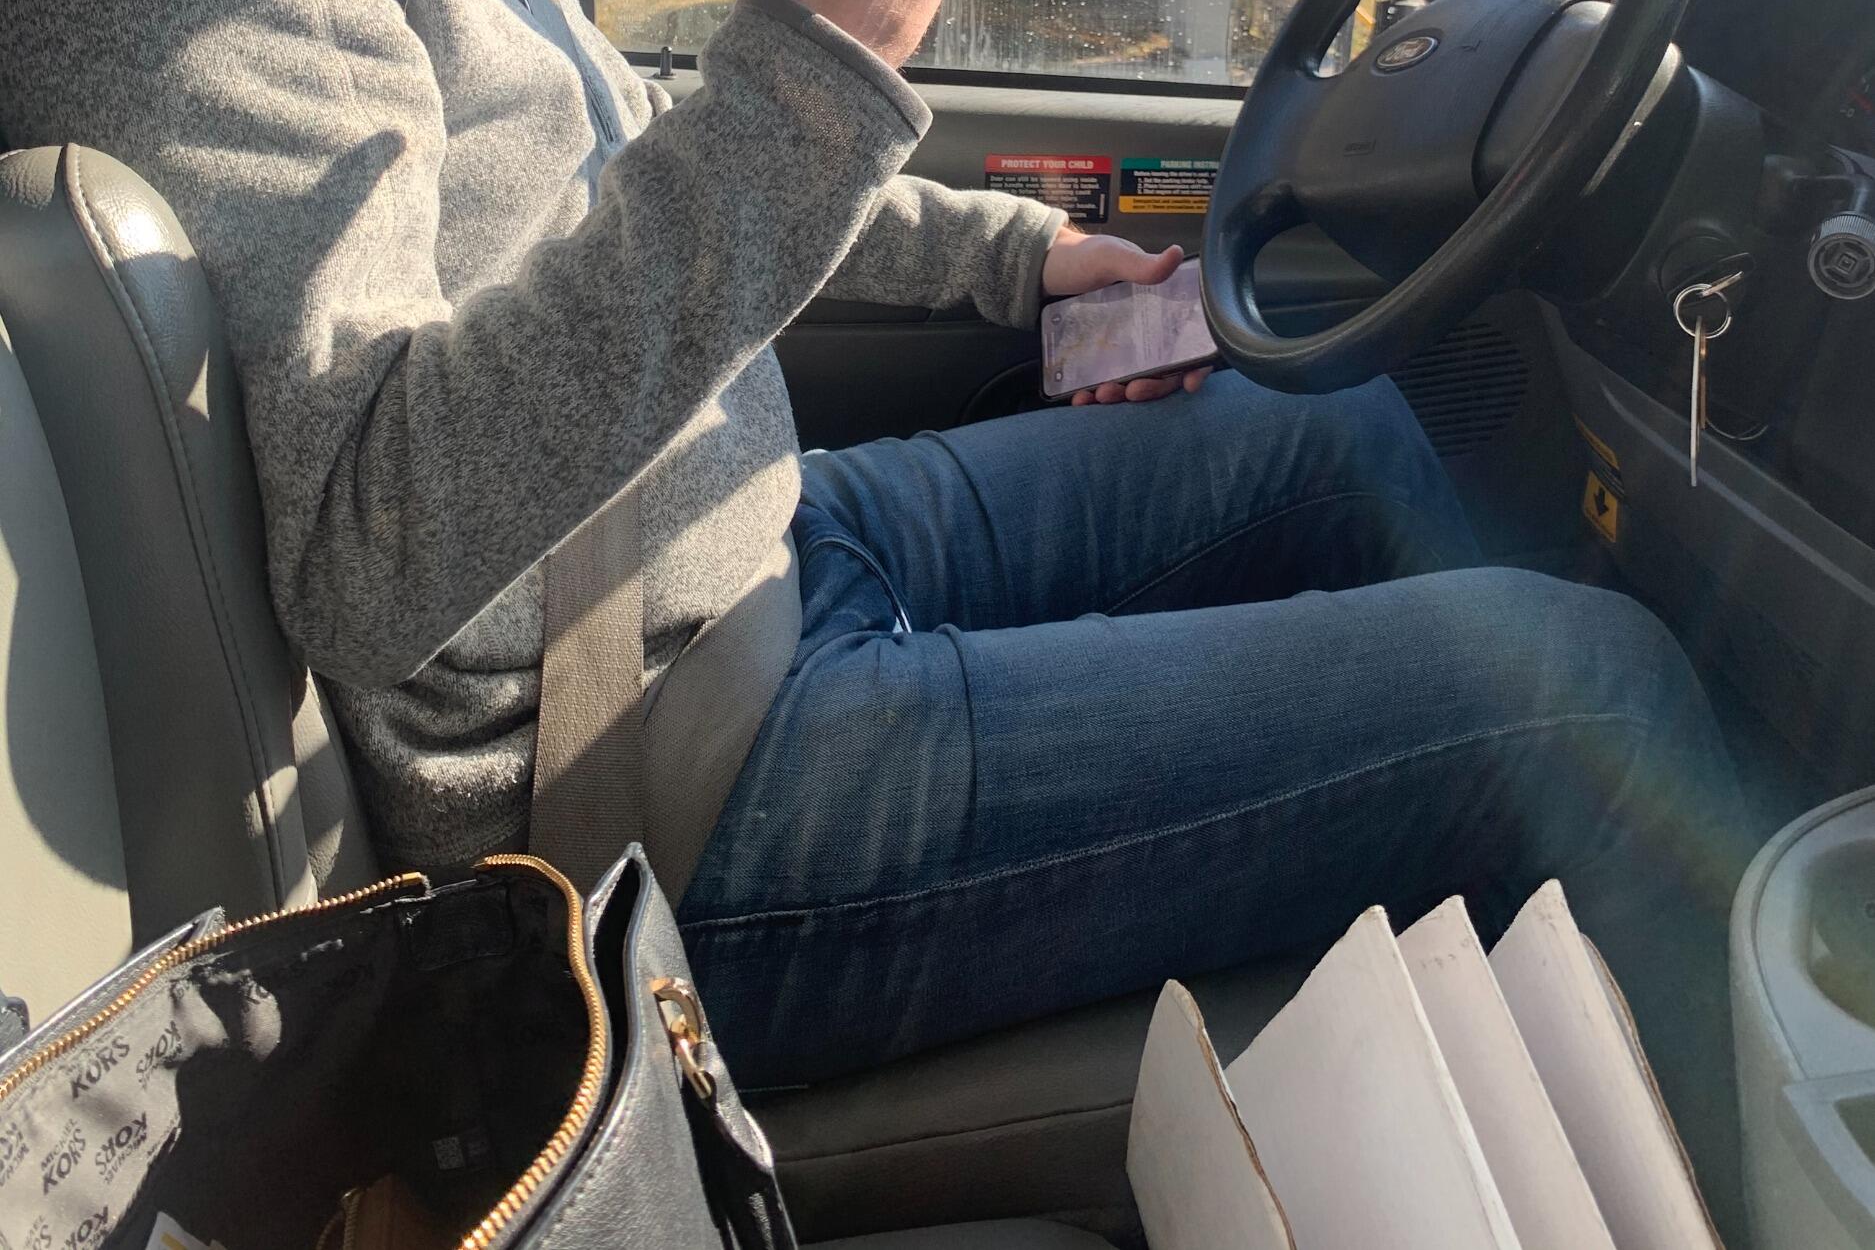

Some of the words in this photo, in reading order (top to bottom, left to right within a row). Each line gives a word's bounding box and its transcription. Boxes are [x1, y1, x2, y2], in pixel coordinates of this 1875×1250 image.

[1001, 159, 1040, 168] PROTECT
[1043, 160, 1066, 169] YOUR
[1068, 160, 1094, 169] CHILD
[71, 1034, 130, 1100] KORS
[43, 1128, 86, 1196] KORS
[95, 1111, 148, 1176] KORS
[103, 1132, 147, 1185] MICHAEL
[60, 1205, 109, 1250] KOR
